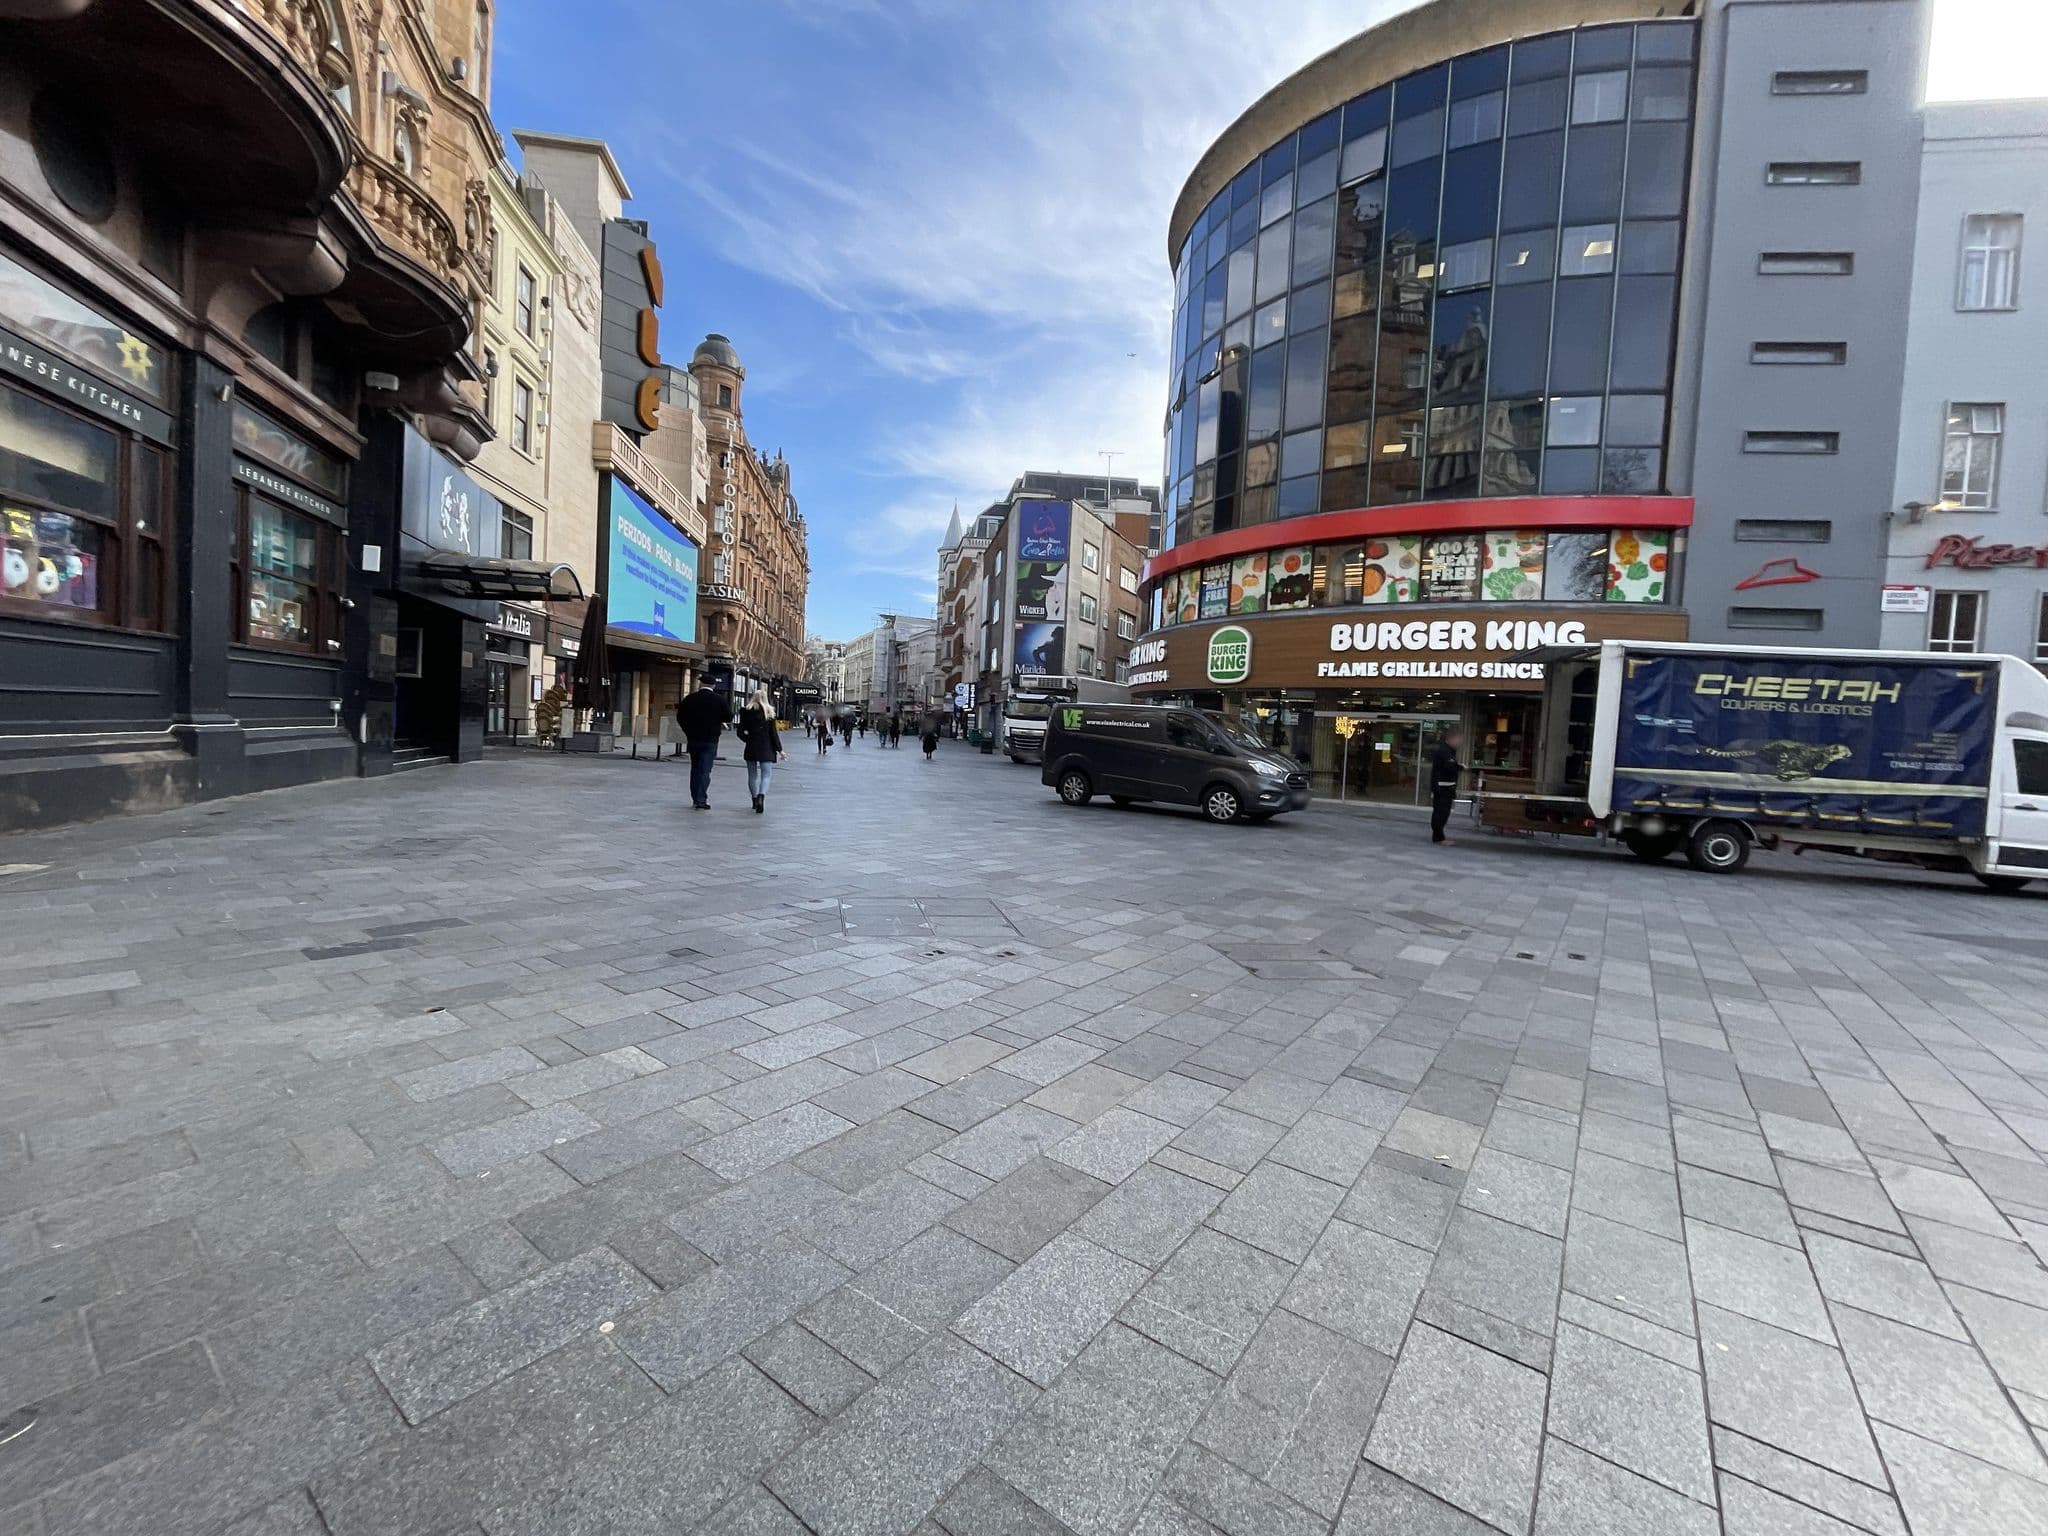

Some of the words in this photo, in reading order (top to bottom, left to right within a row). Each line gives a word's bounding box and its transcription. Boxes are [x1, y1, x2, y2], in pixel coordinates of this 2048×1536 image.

[0, 344, 60, 381] NESE
[68, 376, 142, 421] KITCHEN
[239, 464, 292, 496] LEBANESE
[294, 491, 331, 514] KITCHEN
[721, 417, 738, 577] HIPPODROME
[1433, 540, 1478, 555] 100%
[1431, 553, 1478, 567] MEAT
[1430, 566, 1476, 581] FREE
[697, 584, 746, 602] CASINO
[1019, 604, 1045, 616] WICKED
[504, 610, 531, 637] Italia
[1330, 620, 1477, 652] BURGER
[1485, 620, 1586, 650] KING
[1140, 639, 1166, 665] KING
[1211, 644, 1247, 656] BURGER
[1014, 663, 1047, 675] Matilda
[1210, 655, 1246, 670] KING
[1317, 662, 1379, 678] FLAME
[1382, 661, 1478, 678] GRILLING
[1481, 662, 1544, 679] SINCE
[1695, 674, 1901, 703] CHEETAH
[1720, 699, 1786, 713] COURIERS
[1789, 702, 1800, 713] &
[1803, 703, 1873, 716] LOGISTICS
